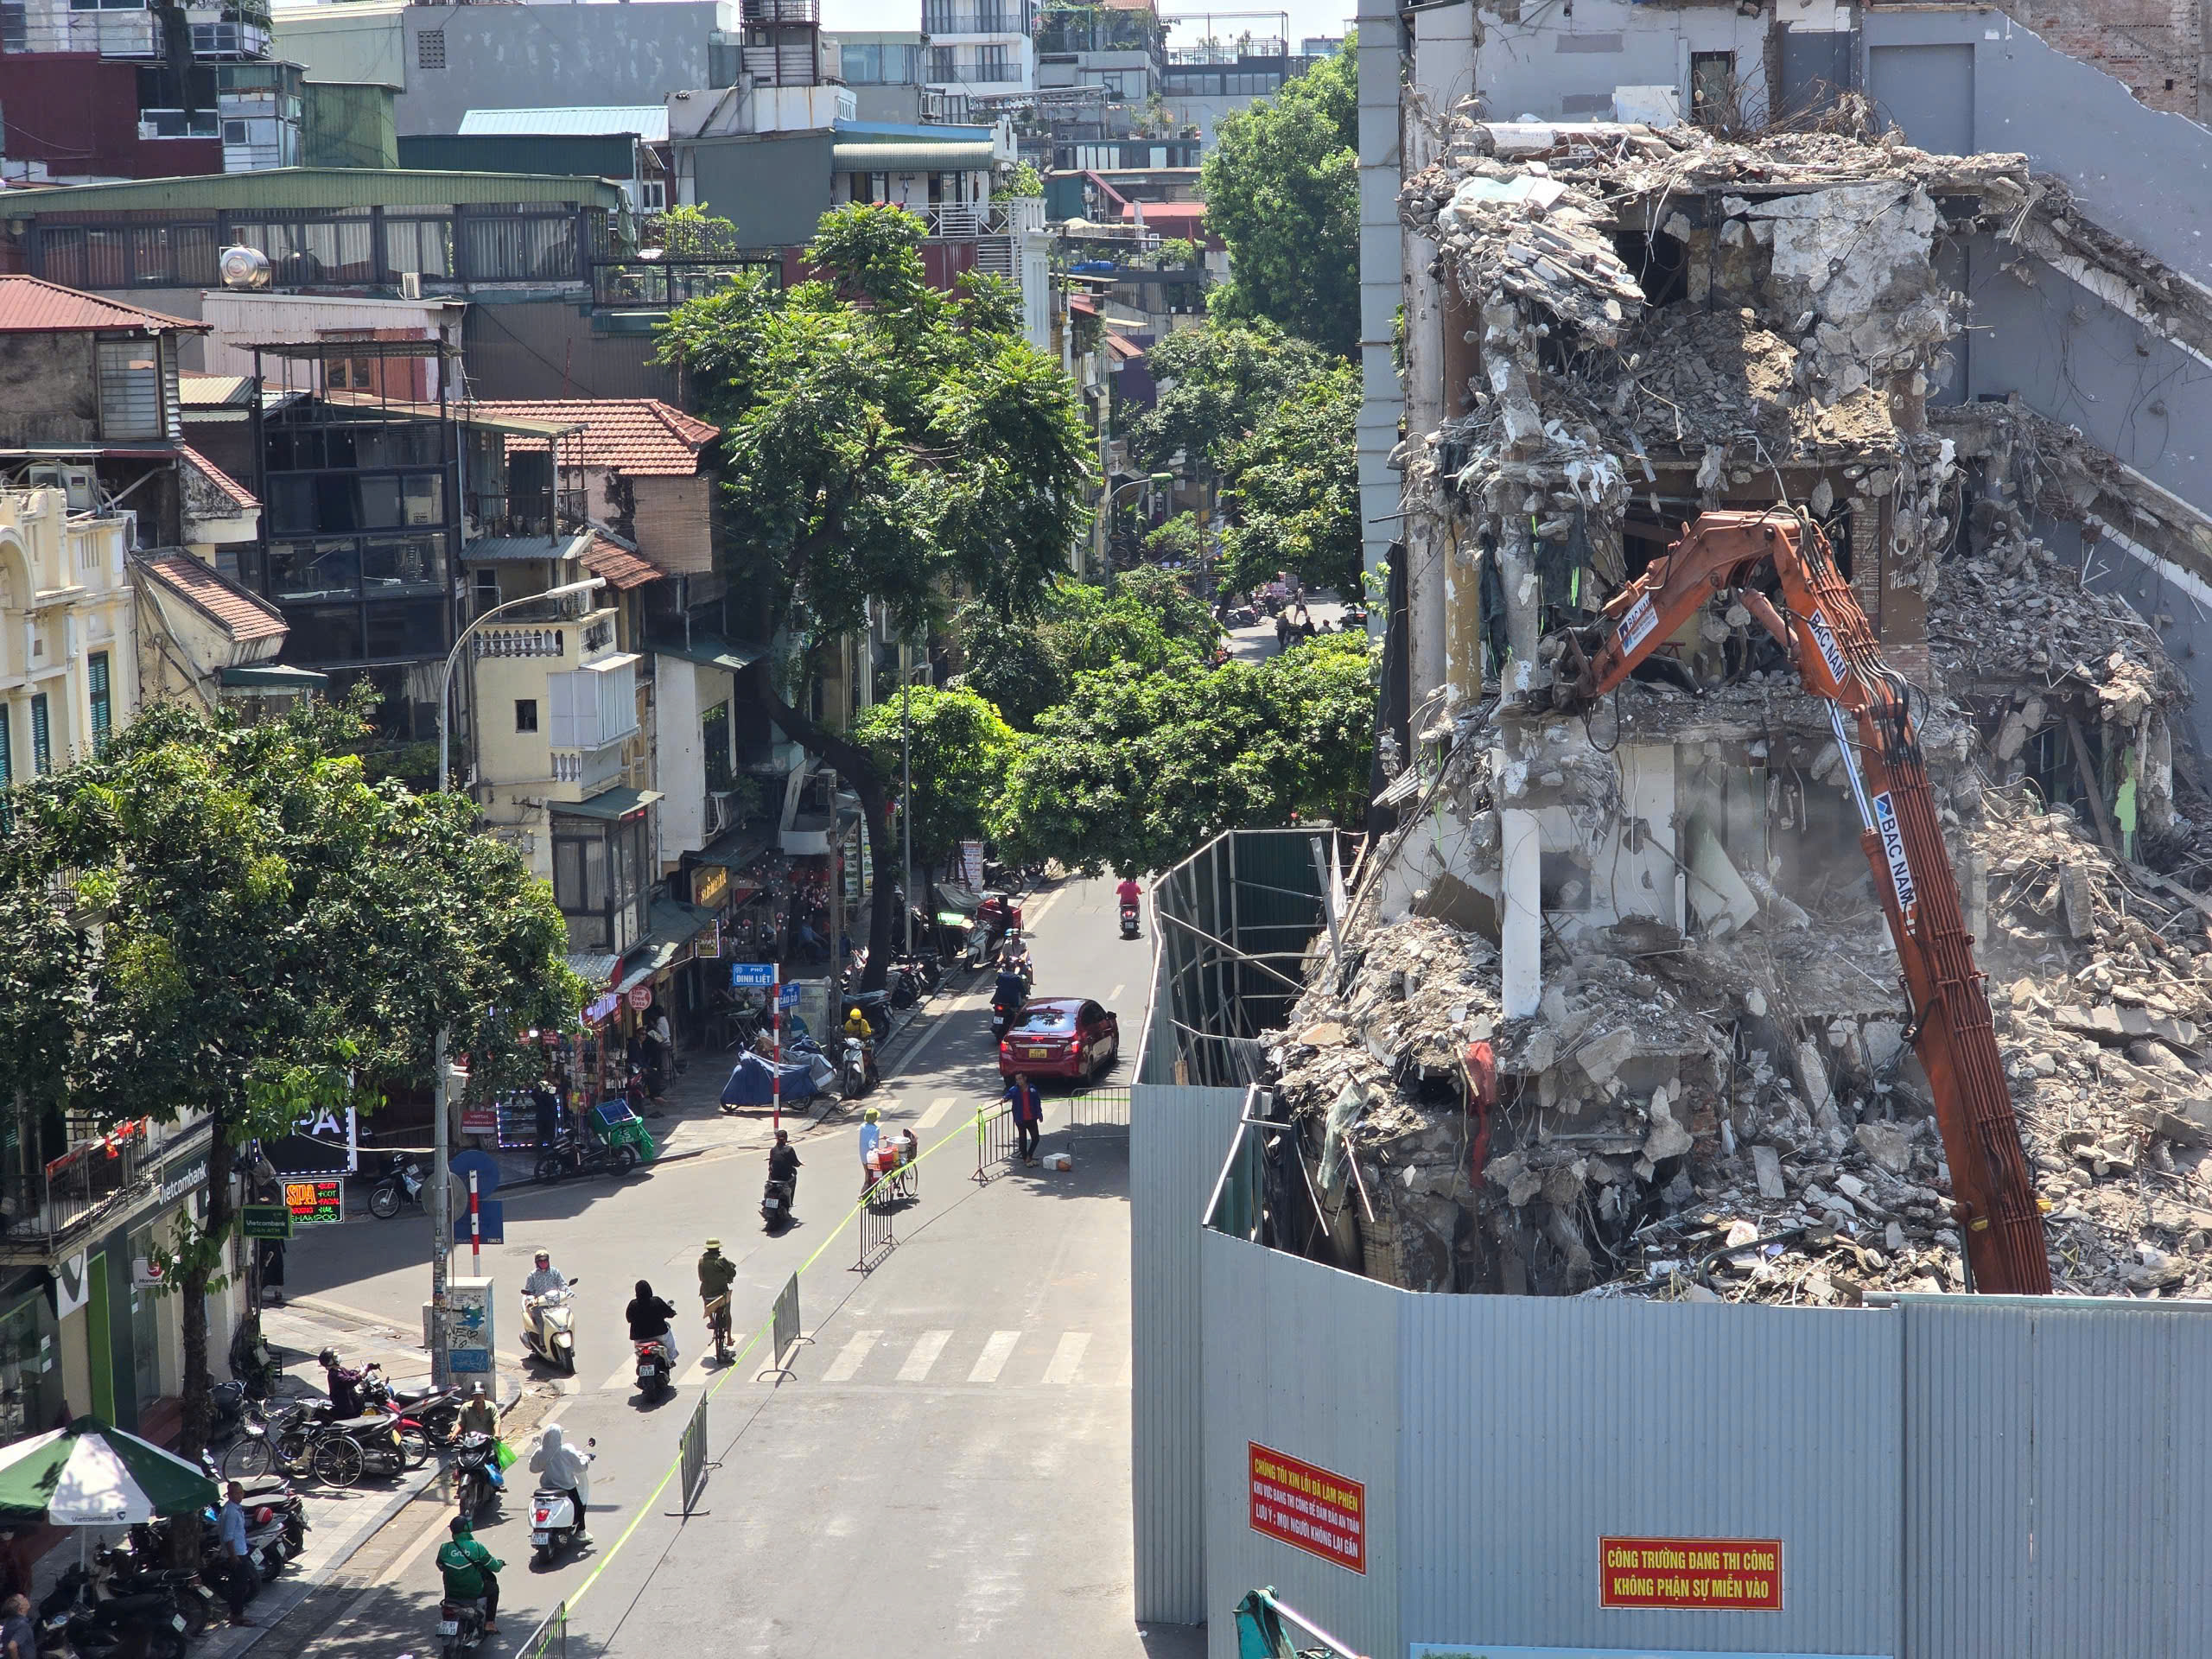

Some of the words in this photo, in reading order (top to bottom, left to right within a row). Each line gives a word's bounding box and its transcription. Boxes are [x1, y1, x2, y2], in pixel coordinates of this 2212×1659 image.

[1825, 643, 1846, 681] NAM
[1882, 817, 1903, 859] BAC
[1892, 861, 1915, 906] NAM
[755, 974, 771, 984] LIỆT
[159, 1160, 207, 1205] Vietcombank
[286, 1184, 317, 1206] SPA
[1255, 1458, 1276, 1479] CHÚNG
[1277, 1465, 1287, 1484] TÔI
[1288, 1470, 1300, 1491] XIN
[1312, 1479, 1321, 1498] ĐÃ
[1323, 1484, 1337, 1504] LÀM
[1253, 1480, 1263, 1497] KHU
[1263, 1484, 1273, 1502] VỰC
[1287, 1492, 1295, 1509] THI
[1295, 1494, 1309, 1512] CÔNG
[1338, 1514, 1346, 1529] AN
[1346, 1516, 1360, 1535] TOÀN
[1255, 1503, 1268, 1522] LƯU
[1268, 1506, 1273, 1524] Ý
[1277, 1512, 1289, 1532] MỌI
[1290, 1515, 1310, 1539] NGƯỜI
[1310, 1525, 1332, 1548] KHÔNG
[1333, 1535, 1344, 1554] LẠI
[1607, 1547, 1639, 1568] CÔNG
[1641, 1547, 1686, 1569] TRƯỜNG
[1688, 1551, 1719, 1571] ĐANG
[1722, 1552, 1740, 1571] THI
[1743, 1549, 1775, 1571] CÔNG
[1613, 1574, 1654, 1596] KHÔNG
[1656, 1575, 1689, 1601] PHẬN
[1693, 1577, 1710, 1601] SỰ
[1712, 1573, 1743, 1598] MIỄN
[1745, 1576, 1769, 1599] VÀO
